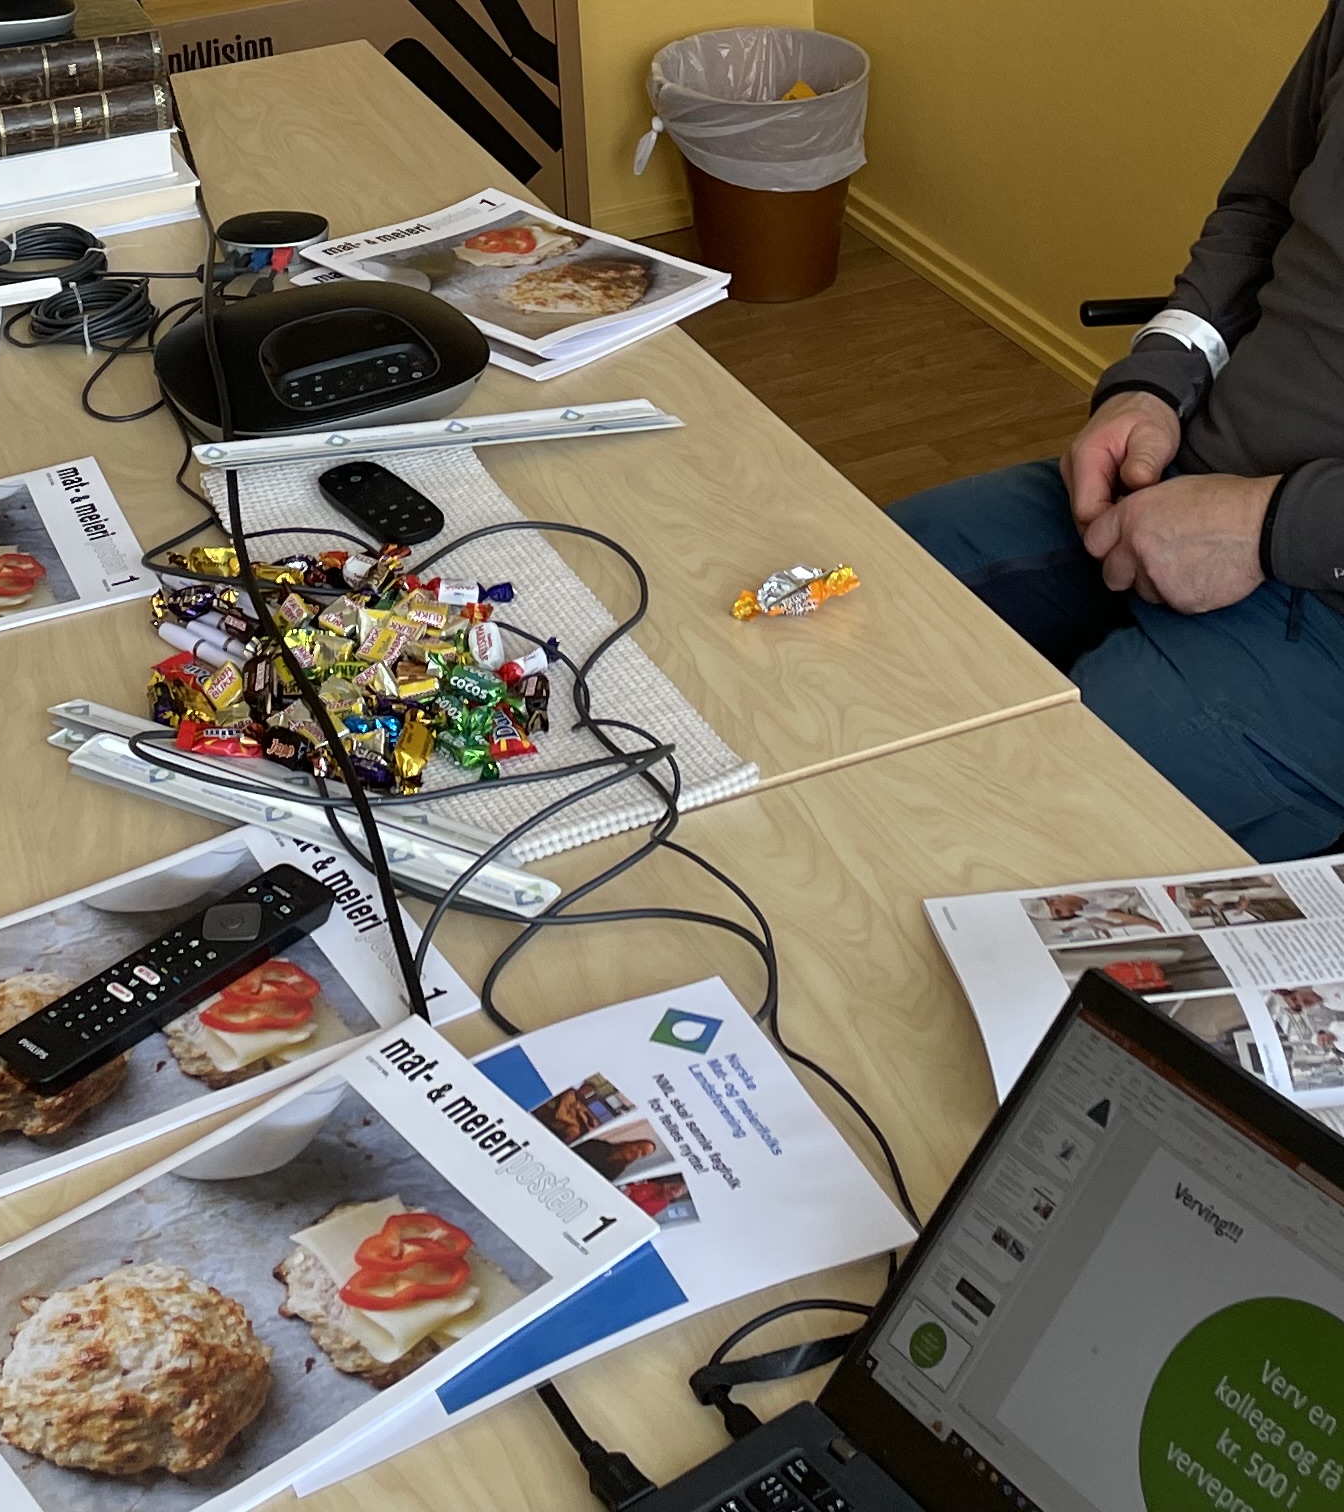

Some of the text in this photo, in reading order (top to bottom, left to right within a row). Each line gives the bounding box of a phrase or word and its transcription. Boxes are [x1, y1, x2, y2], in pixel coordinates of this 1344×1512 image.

[364, 238, 378, 246] &
[479, 198, 497, 208] 1
[56, 466, 90, 494] mat-
[69, 494, 91, 505] &
[111, 575, 141, 587] 1
[449, 675, 489, 701] COCOS
[312, 856, 337, 875] &
[424, 986, 449, 1002] 1
[17, 1037, 50, 1061] PHILIPS
[724, 1052, 757, 1092] Norske
[647, 1096, 662, 1117] for
[659, 1114, 684, 1144] felles
[652, 1072, 742, 1191] NML skal samle fagfolk
[688, 1062, 747, 1139] Landsforening
[707, 1057, 783, 1157] Mat- og meierifolks
[379, 1037, 439, 1084] mat-
[426, 1082, 454, 1105] &
[581, 1214, 618, 1244] 1
[1174, 1181, 1245, 1245] Verving!!!
[1213, 1375, 1287, 1447] kollega
[1287, 1439, 1319, 1477] og
[1260, 1358, 1338, 1437] Verv en
[1215, 1427, 1302, 1511] kr. 500 i
